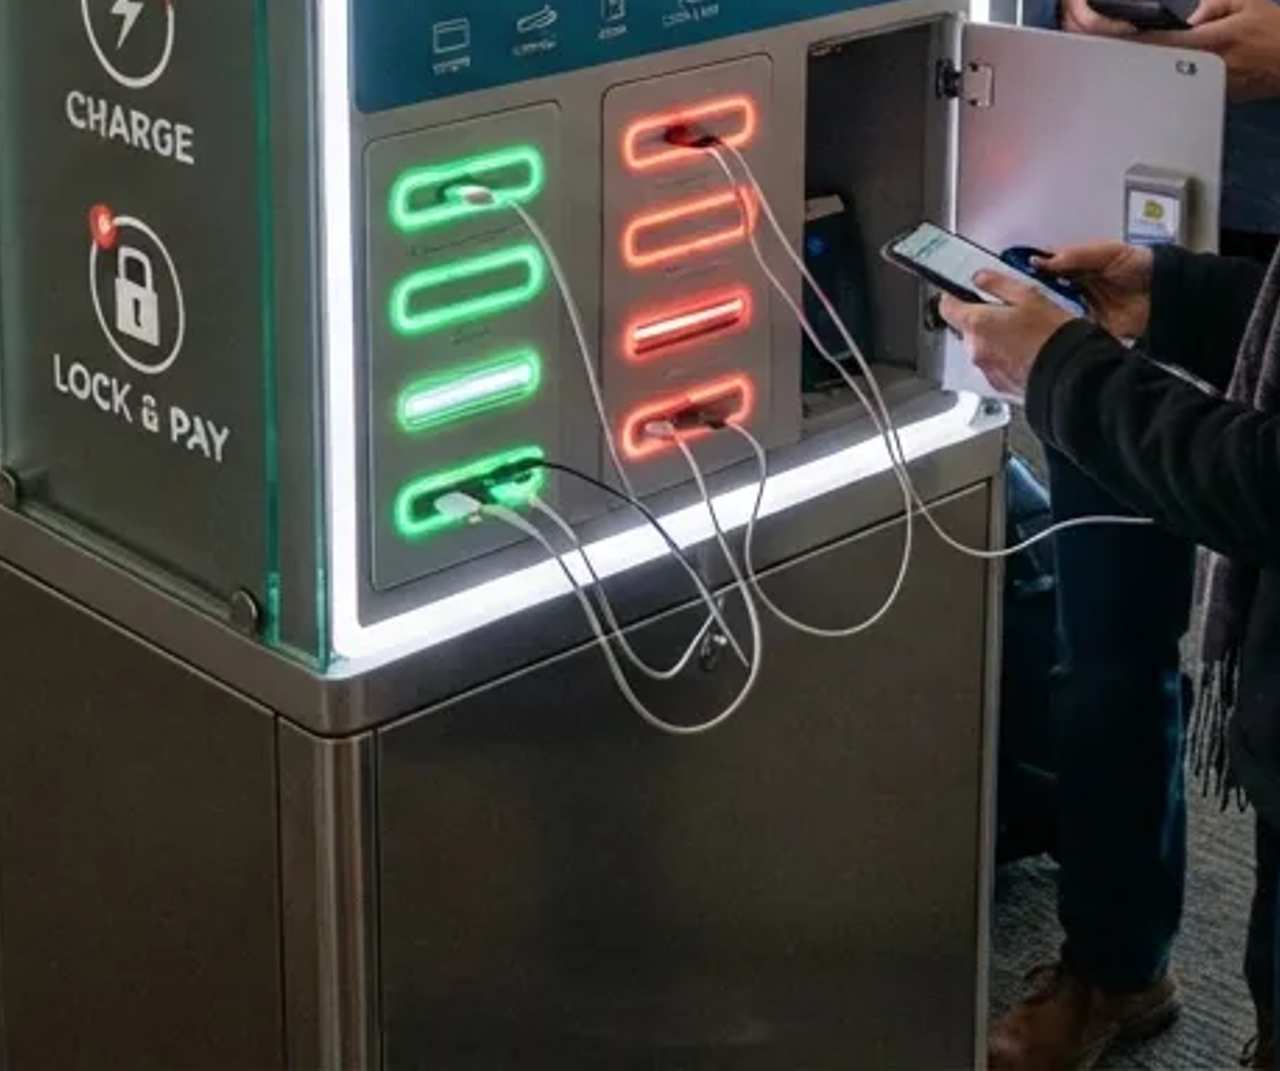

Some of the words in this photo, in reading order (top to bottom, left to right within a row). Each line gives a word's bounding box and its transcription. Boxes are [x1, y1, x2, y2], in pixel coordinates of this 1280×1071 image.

[66, 91, 195, 165] CHARGE
[54, 353, 133, 423] LOCK
[170, 406, 230, 463] PAY
